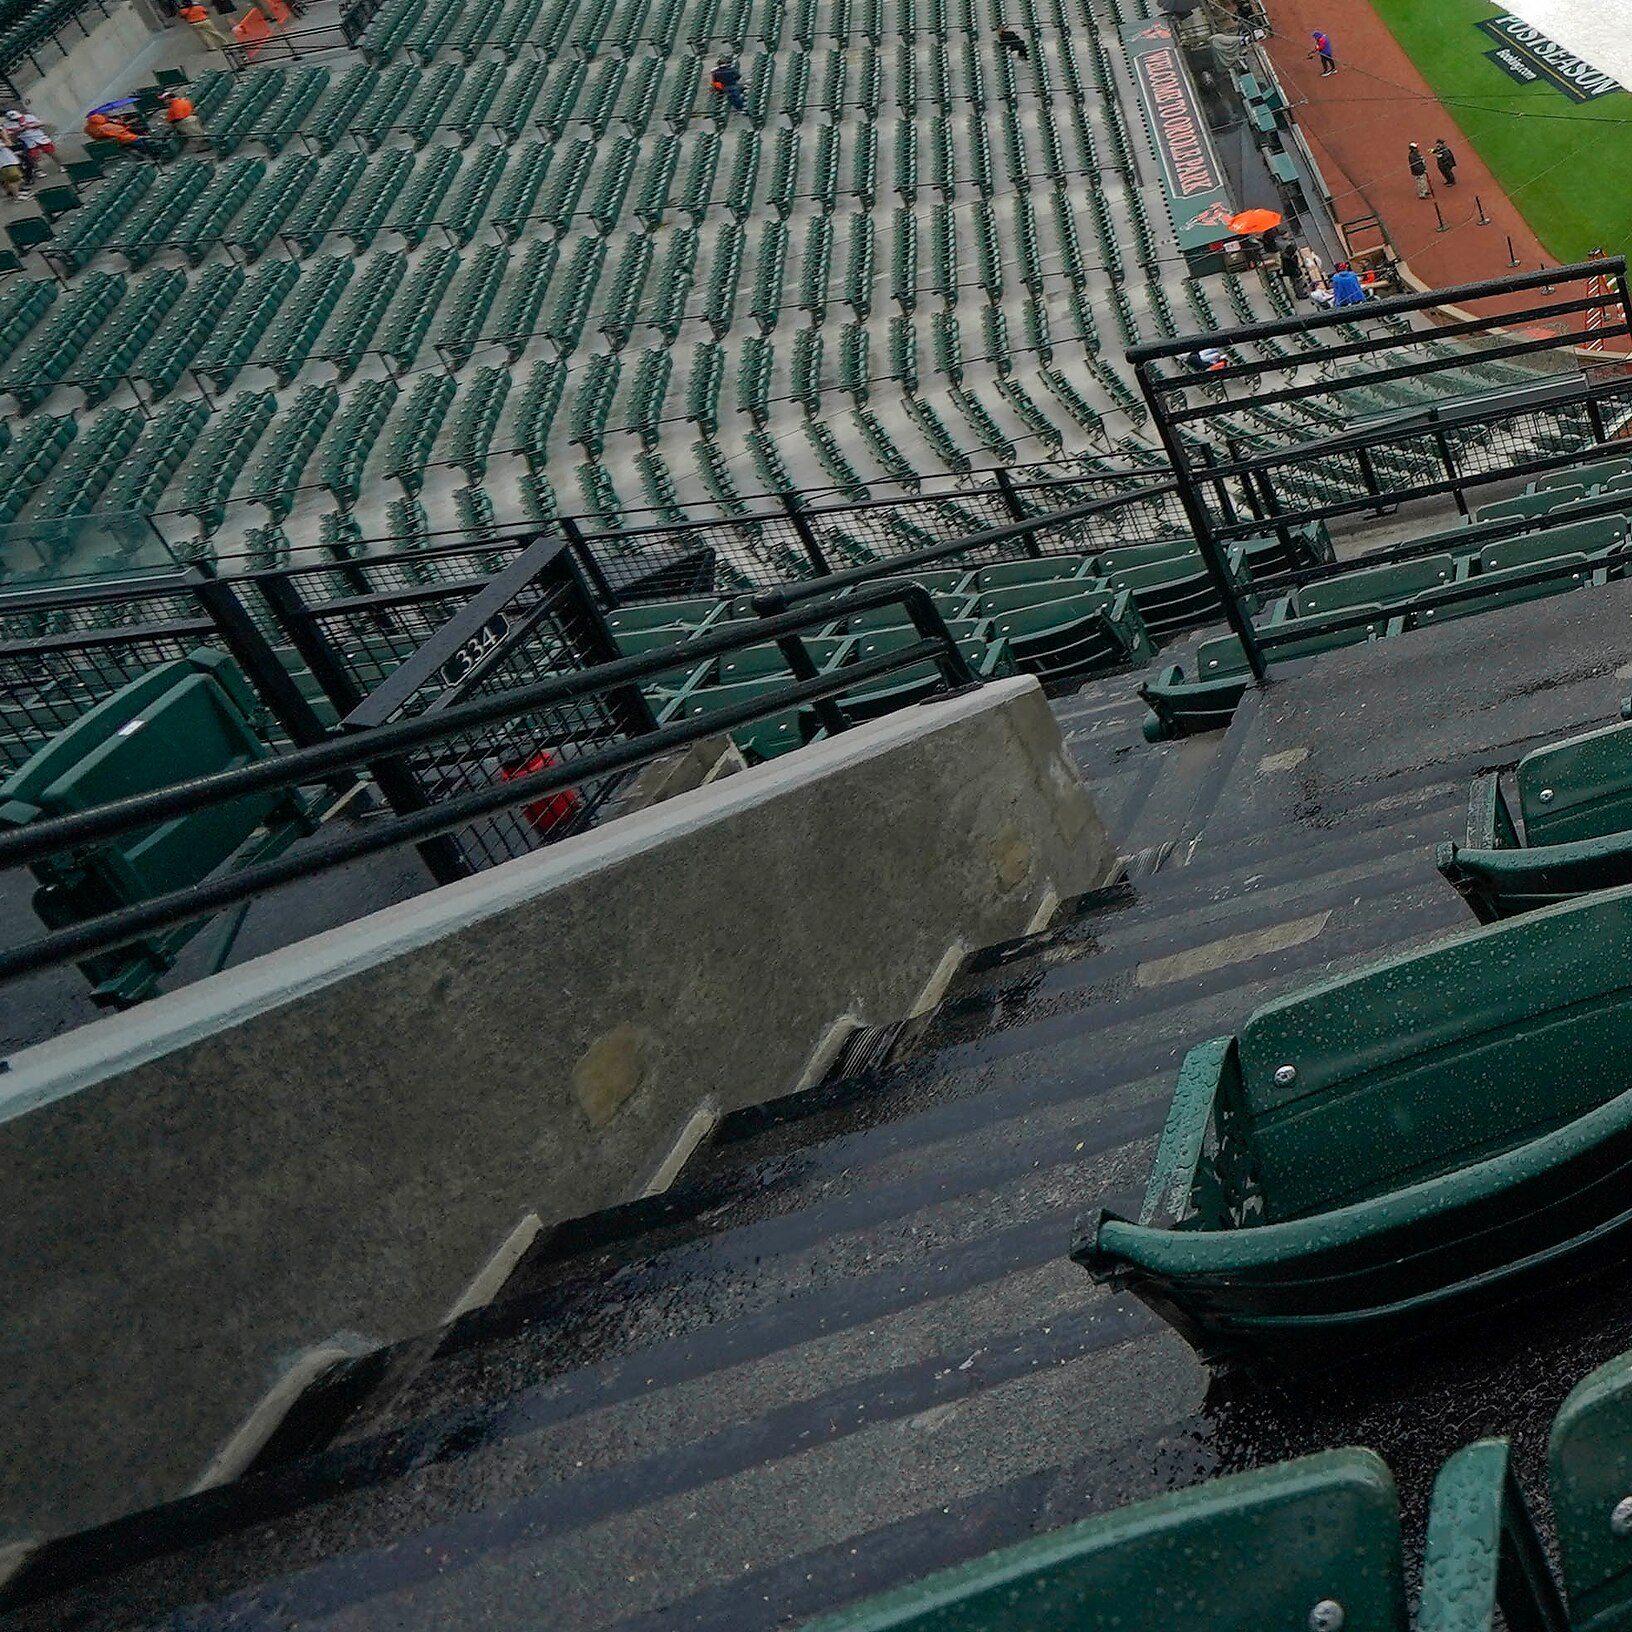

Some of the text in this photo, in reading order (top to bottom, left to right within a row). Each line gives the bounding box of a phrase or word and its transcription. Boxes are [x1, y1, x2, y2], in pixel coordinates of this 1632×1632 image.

[1496, 48, 1537, 81] Booking.com
[1143, 50, 1213, 196] WELCOME TO ORIOLE PARK
